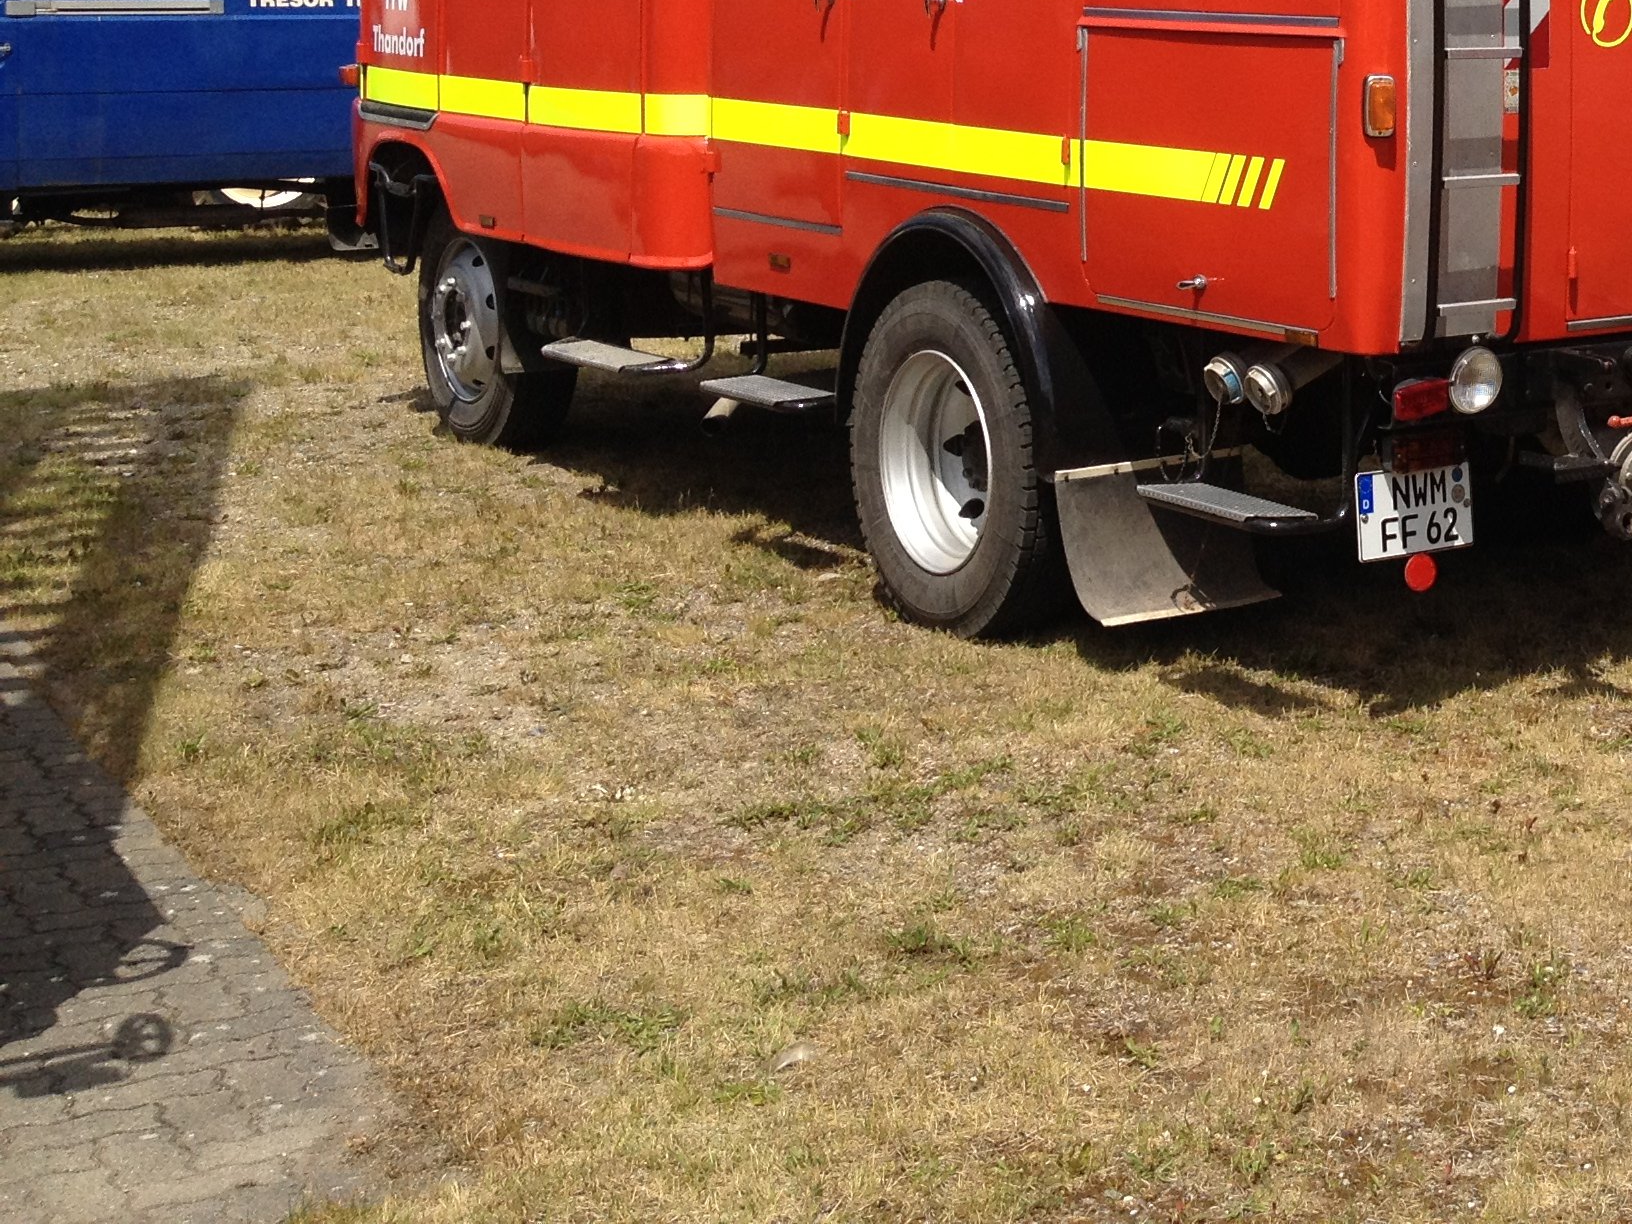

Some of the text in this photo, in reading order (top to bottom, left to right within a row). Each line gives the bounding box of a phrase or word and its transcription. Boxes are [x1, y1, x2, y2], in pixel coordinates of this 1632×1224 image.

[373, 24, 425, 58] Thandorf
[1362, 499, 1370, 510] D
[1391, 470, 1447, 511] NWM
[1381, 506, 1459, 553] FF 62
